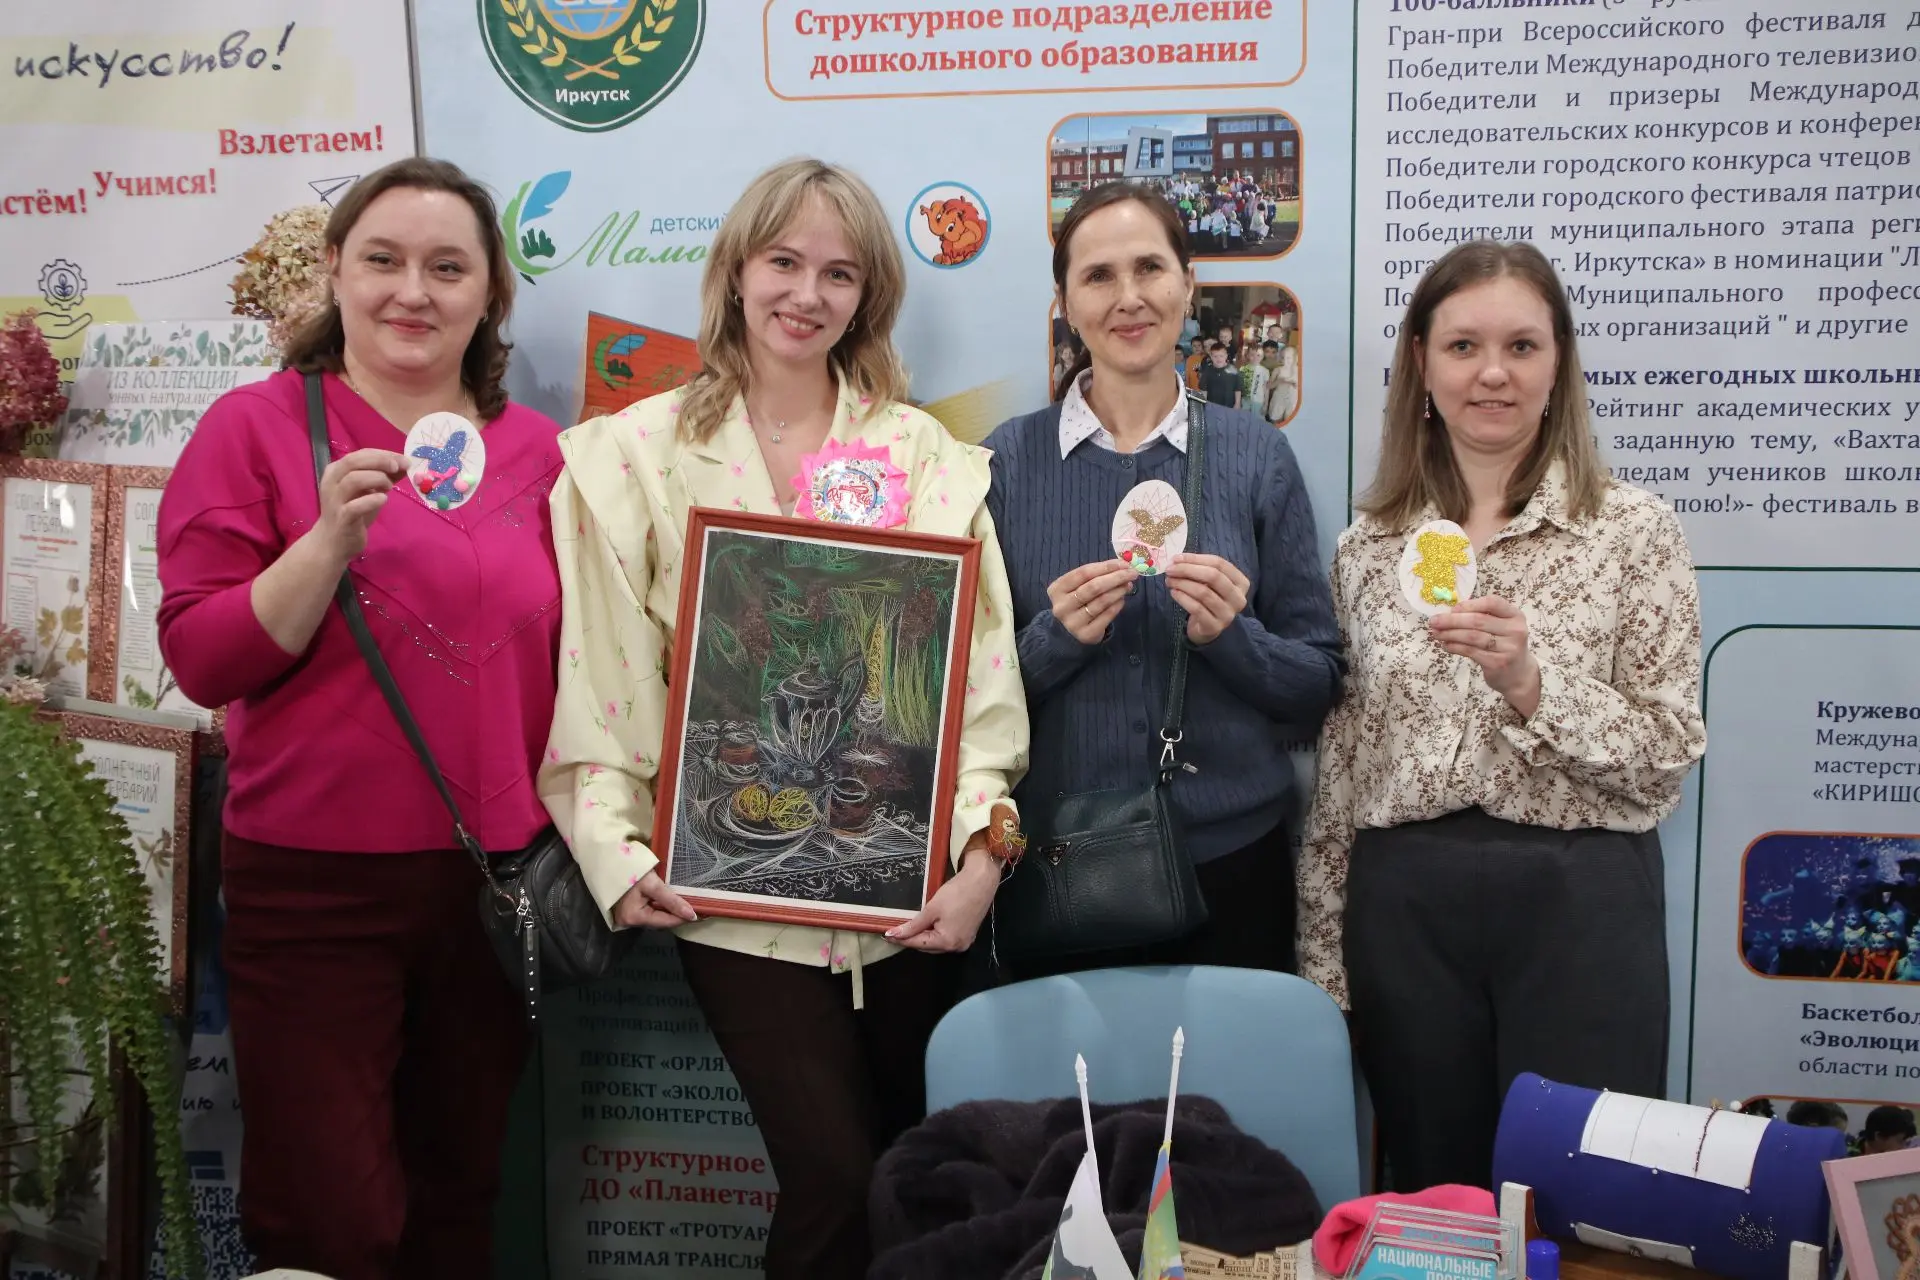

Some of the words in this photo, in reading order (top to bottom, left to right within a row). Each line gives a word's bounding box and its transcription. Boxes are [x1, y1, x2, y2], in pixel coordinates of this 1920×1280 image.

[795, 8, 1004, 41] Структурное
[1012, 0, 1273, 33] подразделение
[1388, 25, 1503, 50] Гран-при
[1523, 16, 1725, 46] Всероссийского
[1745, 12, 1886, 39] фестиваля
[14, 21, 296, 88] искусство!
[810, 47, 1032, 79] дошкольного
[1041, 40, 1259, 74] образования
[1387, 57, 1539, 81] Победители
[1546, 51, 1770, 78] Международного
[555, 87, 631, 106] Иркутск
[1387, 90, 1537, 114] Победители
[1566, 92, 1581, 107] и
[1609, 88, 1721, 110] призеры
[1749, 80, 1920, 105] Международ
[218, 124, 384, 156] Взлетаем!
[1386, 123, 1628, 147] исследовательских
[1634, 119, 1769, 143] конкурсов
[1776, 119, 1792, 135] и
[1386, 156, 1536, 180] Победители
[1543, 155, 1686, 179] городского
[1692, 151, 1812, 175] конкурса
[1819, 150, 1911, 169] чтецов
[93, 167, 216, 198] Учимся!
[0, 188, 88, 215] стём!
[1385, 189, 1535, 213] Победители
[1542, 188, 1685, 212] городского
[1690, 183, 1828, 210] фестиваля
[1385, 222, 1534, 245] Победители
[1550, 220, 1765, 245] муниципального
[1781, 219, 1854, 236] этапа
[1574, 251, 1706, 277] Иркутска»
[1714, 255, 1727, 270] в
[1735, 252, 1883, 272] номинации
[1566, 285, 1784, 310] Муниципального
[1606, 314, 1771, 342] организаций
[1795, 320, 1811, 335] и
[1816, 317, 1909, 340] другие
[132, 369, 238, 391] КОЛЛЕКЦИИ
[1643, 368, 1797, 389] ежегодных
[1697, 400, 1892, 421] академических
[1613, 433, 1735, 455] заданную
[1750, 434, 1817, 455] тему,
[1609, 465, 1690, 485] дедам
[1706, 465, 1827, 487] учеников
[1762, 492, 1898, 519] фестиваль
[1816, 700, 1920, 723] Кружево
[1801, 1002, 1920, 1025] Баскетбол
[1800, 1029, 1920, 1055] «Эволюци
[579, 1051, 656, 1070] ПРОЕКТ
[1799, 1057, 1889, 1077] области
[580, 1081, 657, 1099] ПРОЕКТ
[601, 1105, 757, 1127] ВОЛОНТЕРСТВО
[581, 1145, 766, 1176] Структурное
[580, 1178, 621, 1204] ДО
[628, 1179, 780, 1213] «Планетар
[587, 1220, 665, 1238] ПРОЕКТ
[669, 1222, 768, 1242] «ТРОТУАР
[587, 1250, 670, 1267] ПРЯМАЯ
[1377, 1248, 1493, 1280] НАЦИОНАЛЬНЫЕ
